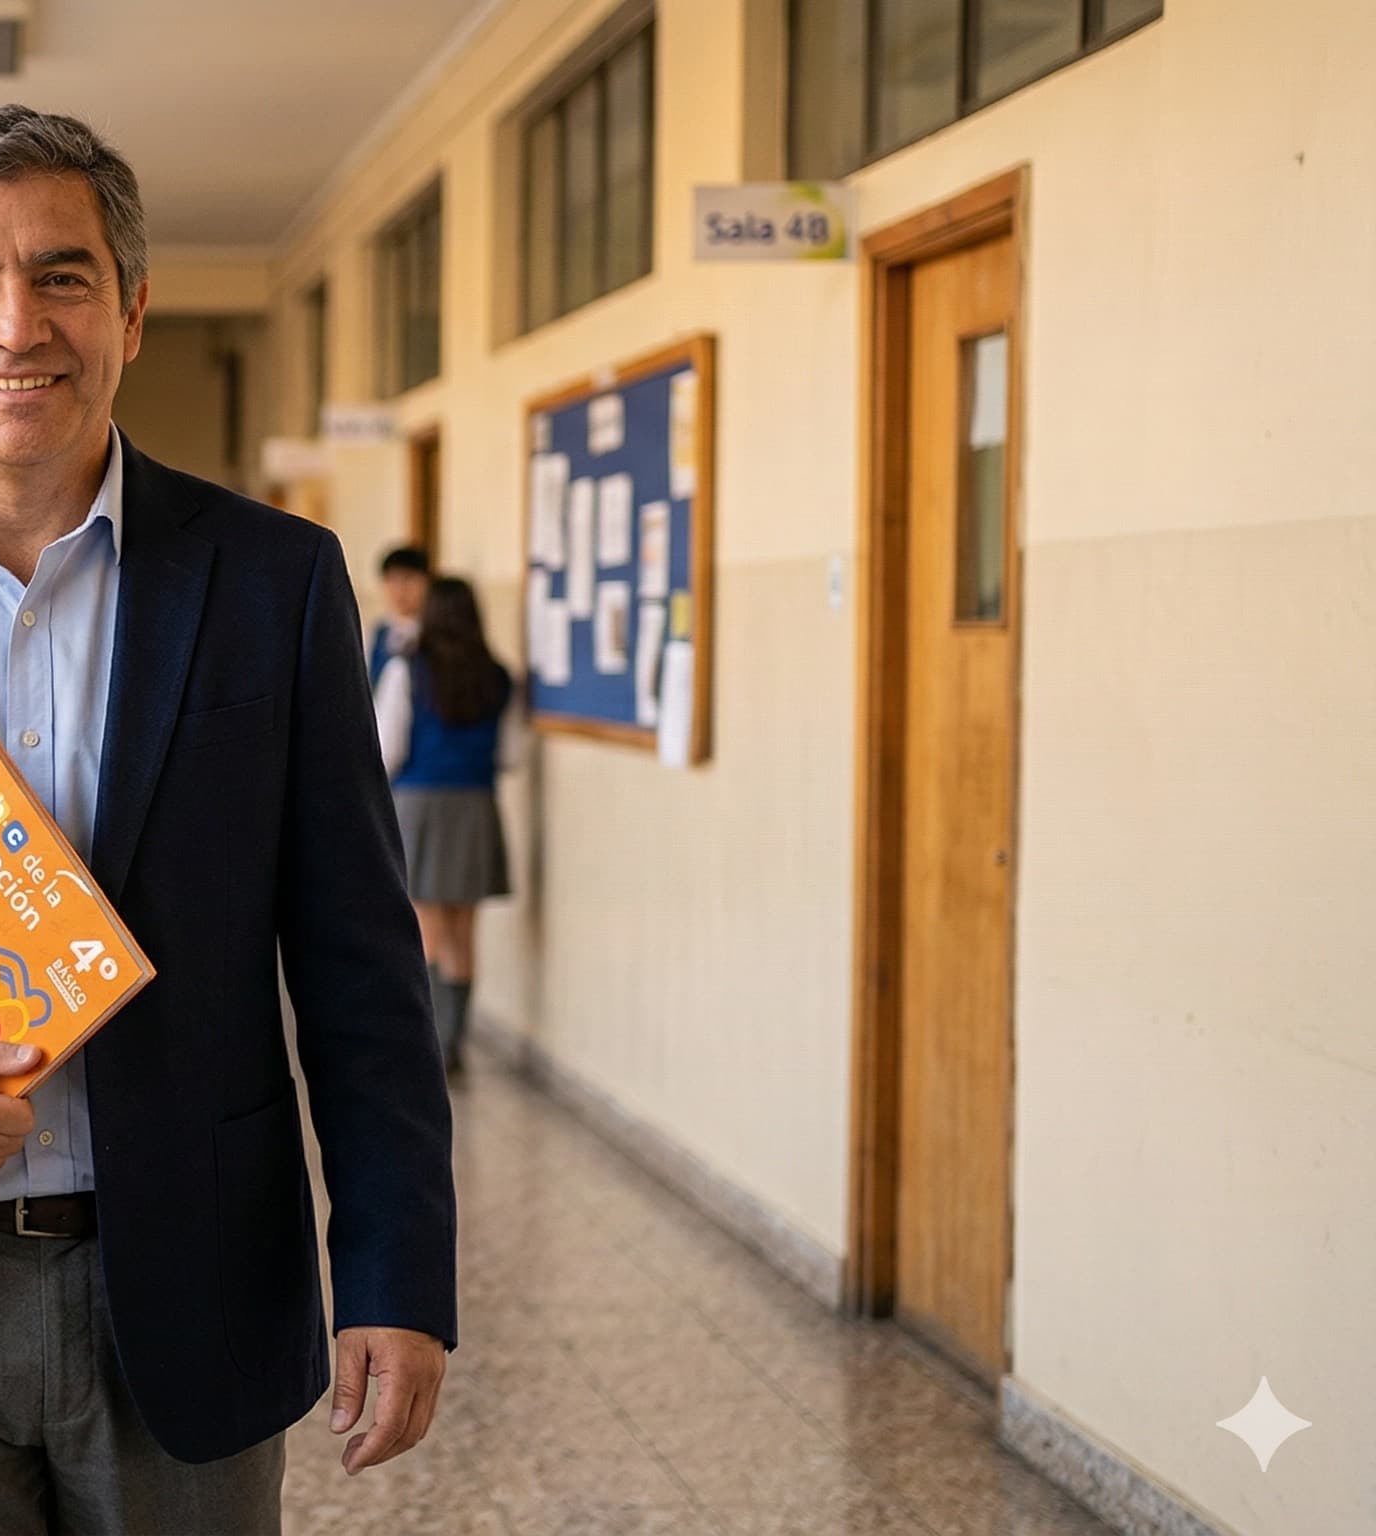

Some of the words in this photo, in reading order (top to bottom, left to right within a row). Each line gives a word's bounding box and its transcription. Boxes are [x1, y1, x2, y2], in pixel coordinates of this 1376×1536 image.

[705, 212, 775, 245] Sala
[23, 854, 46, 885] de
[42, 878, 62, 909] la
[52, 958, 87, 1006] BÁSICO
